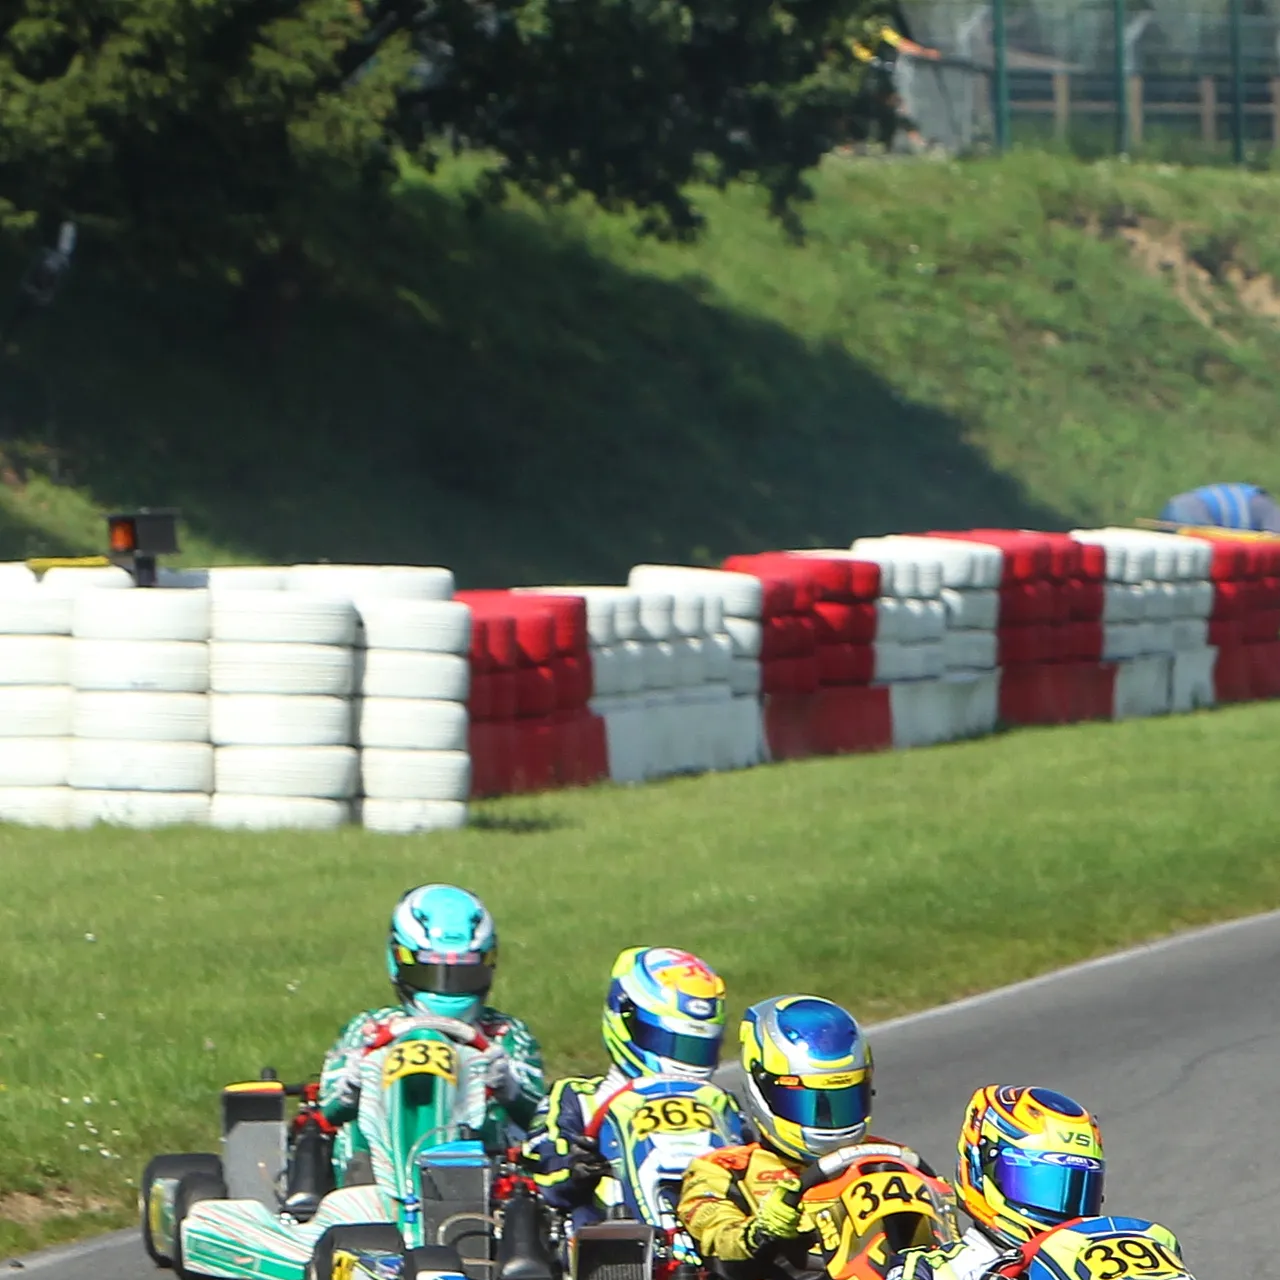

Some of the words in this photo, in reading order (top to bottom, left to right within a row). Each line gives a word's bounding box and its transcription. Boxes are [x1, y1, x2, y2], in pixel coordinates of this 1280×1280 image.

[387, 1043, 453, 1075] 333
[635, 1100, 715, 1135] 365
[1057, 1131, 1091, 1147] VS
